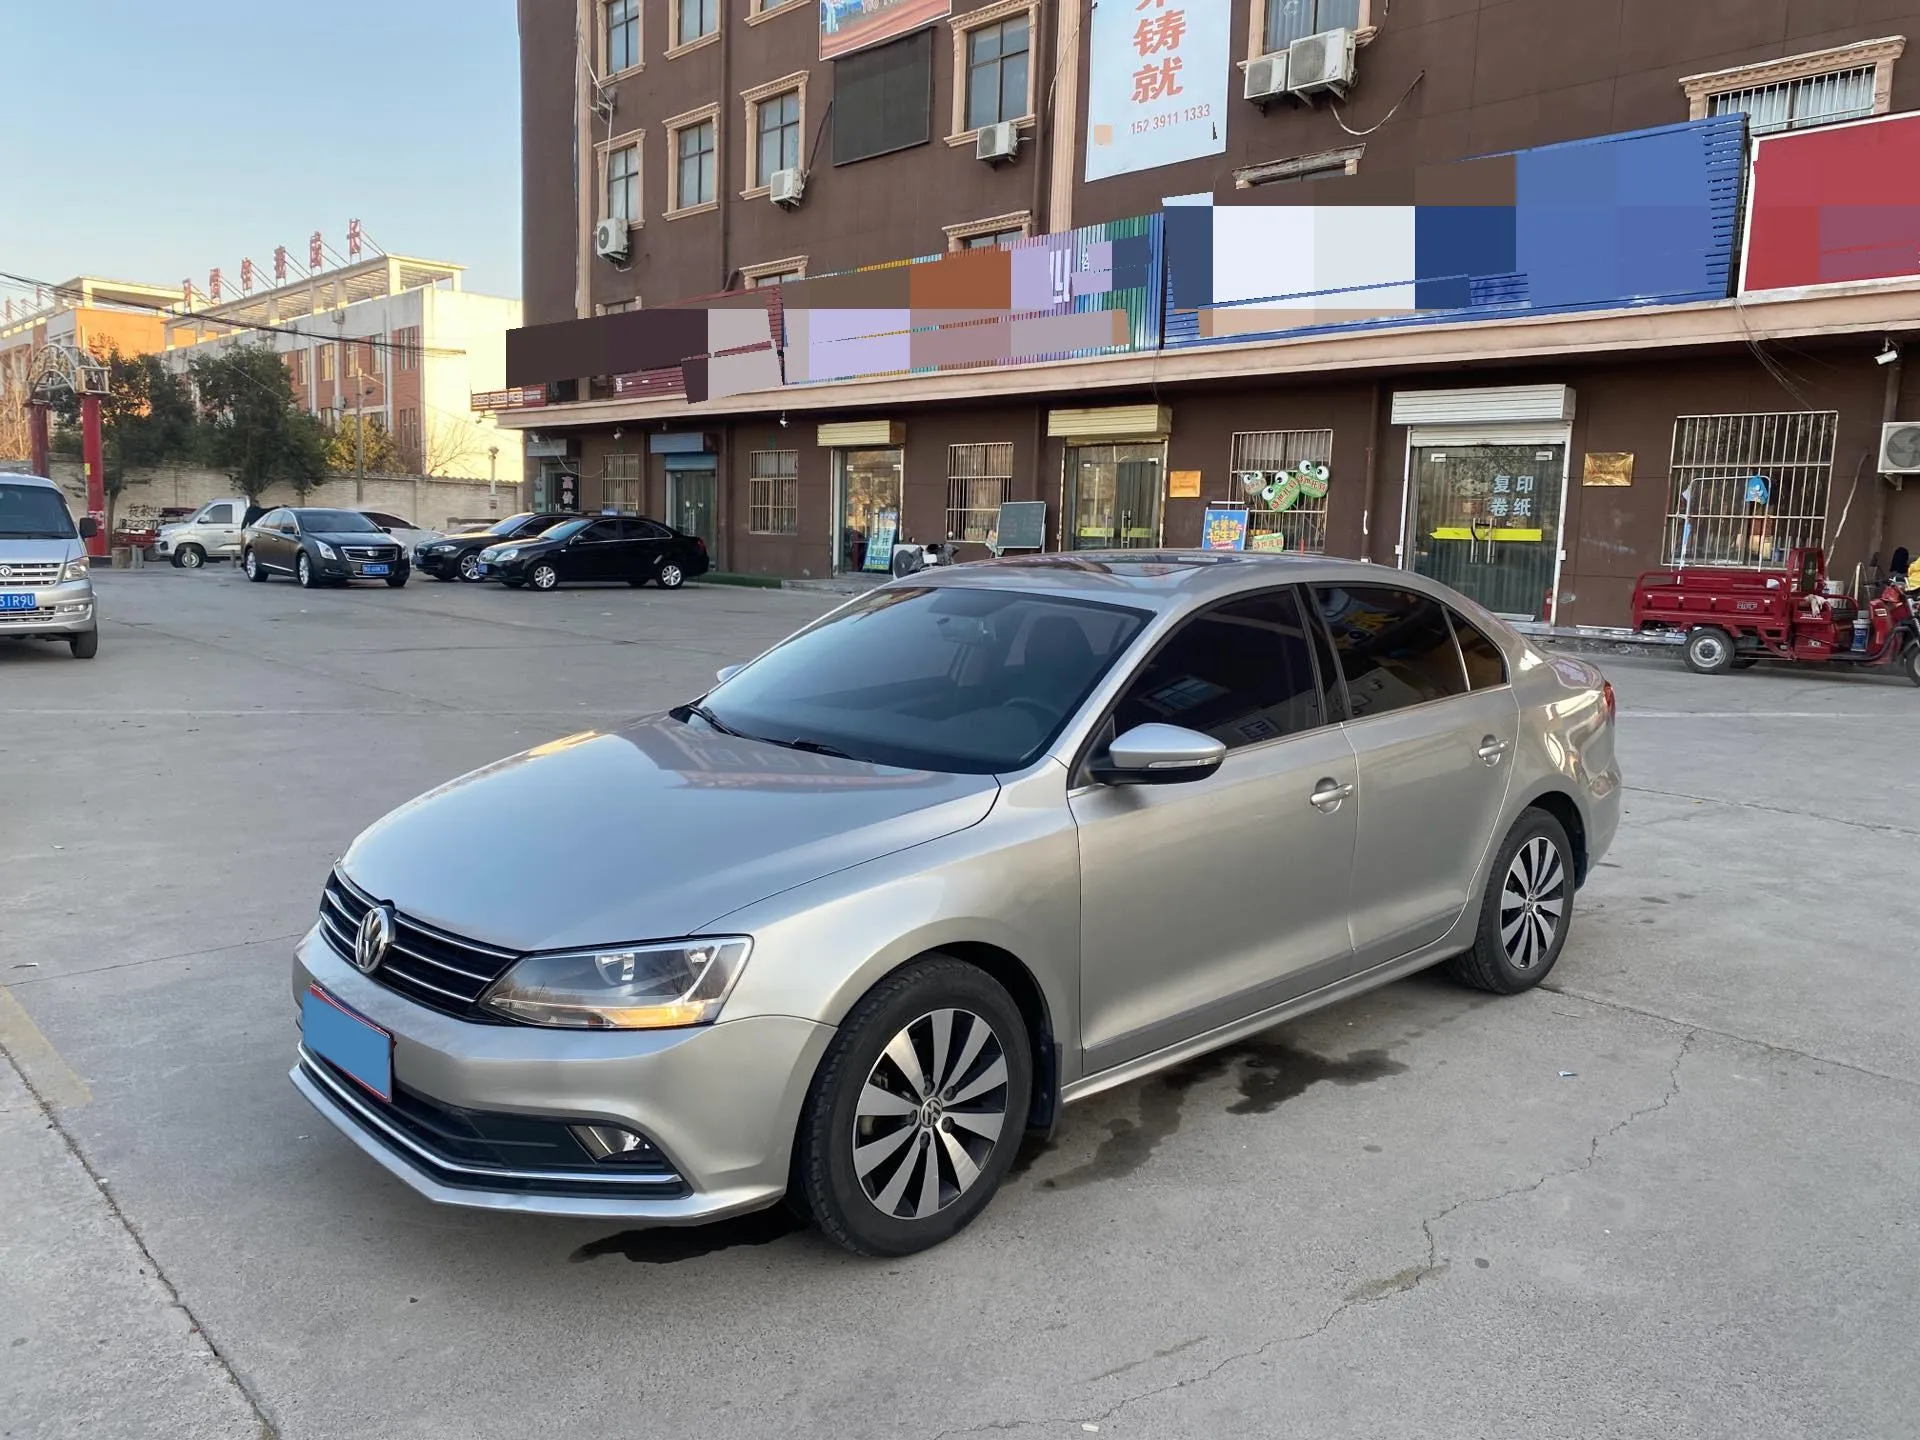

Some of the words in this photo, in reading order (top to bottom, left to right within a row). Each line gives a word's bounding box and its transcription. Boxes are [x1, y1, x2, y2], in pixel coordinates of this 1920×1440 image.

[1131, 119, 1150, 135] 152
[1152, 111, 1179, 131] 3911
[1183, 103, 1211, 122] 1333
[1493, 474, 1535, 494] 复印
[1490, 497, 1532, 517] 卷纸
